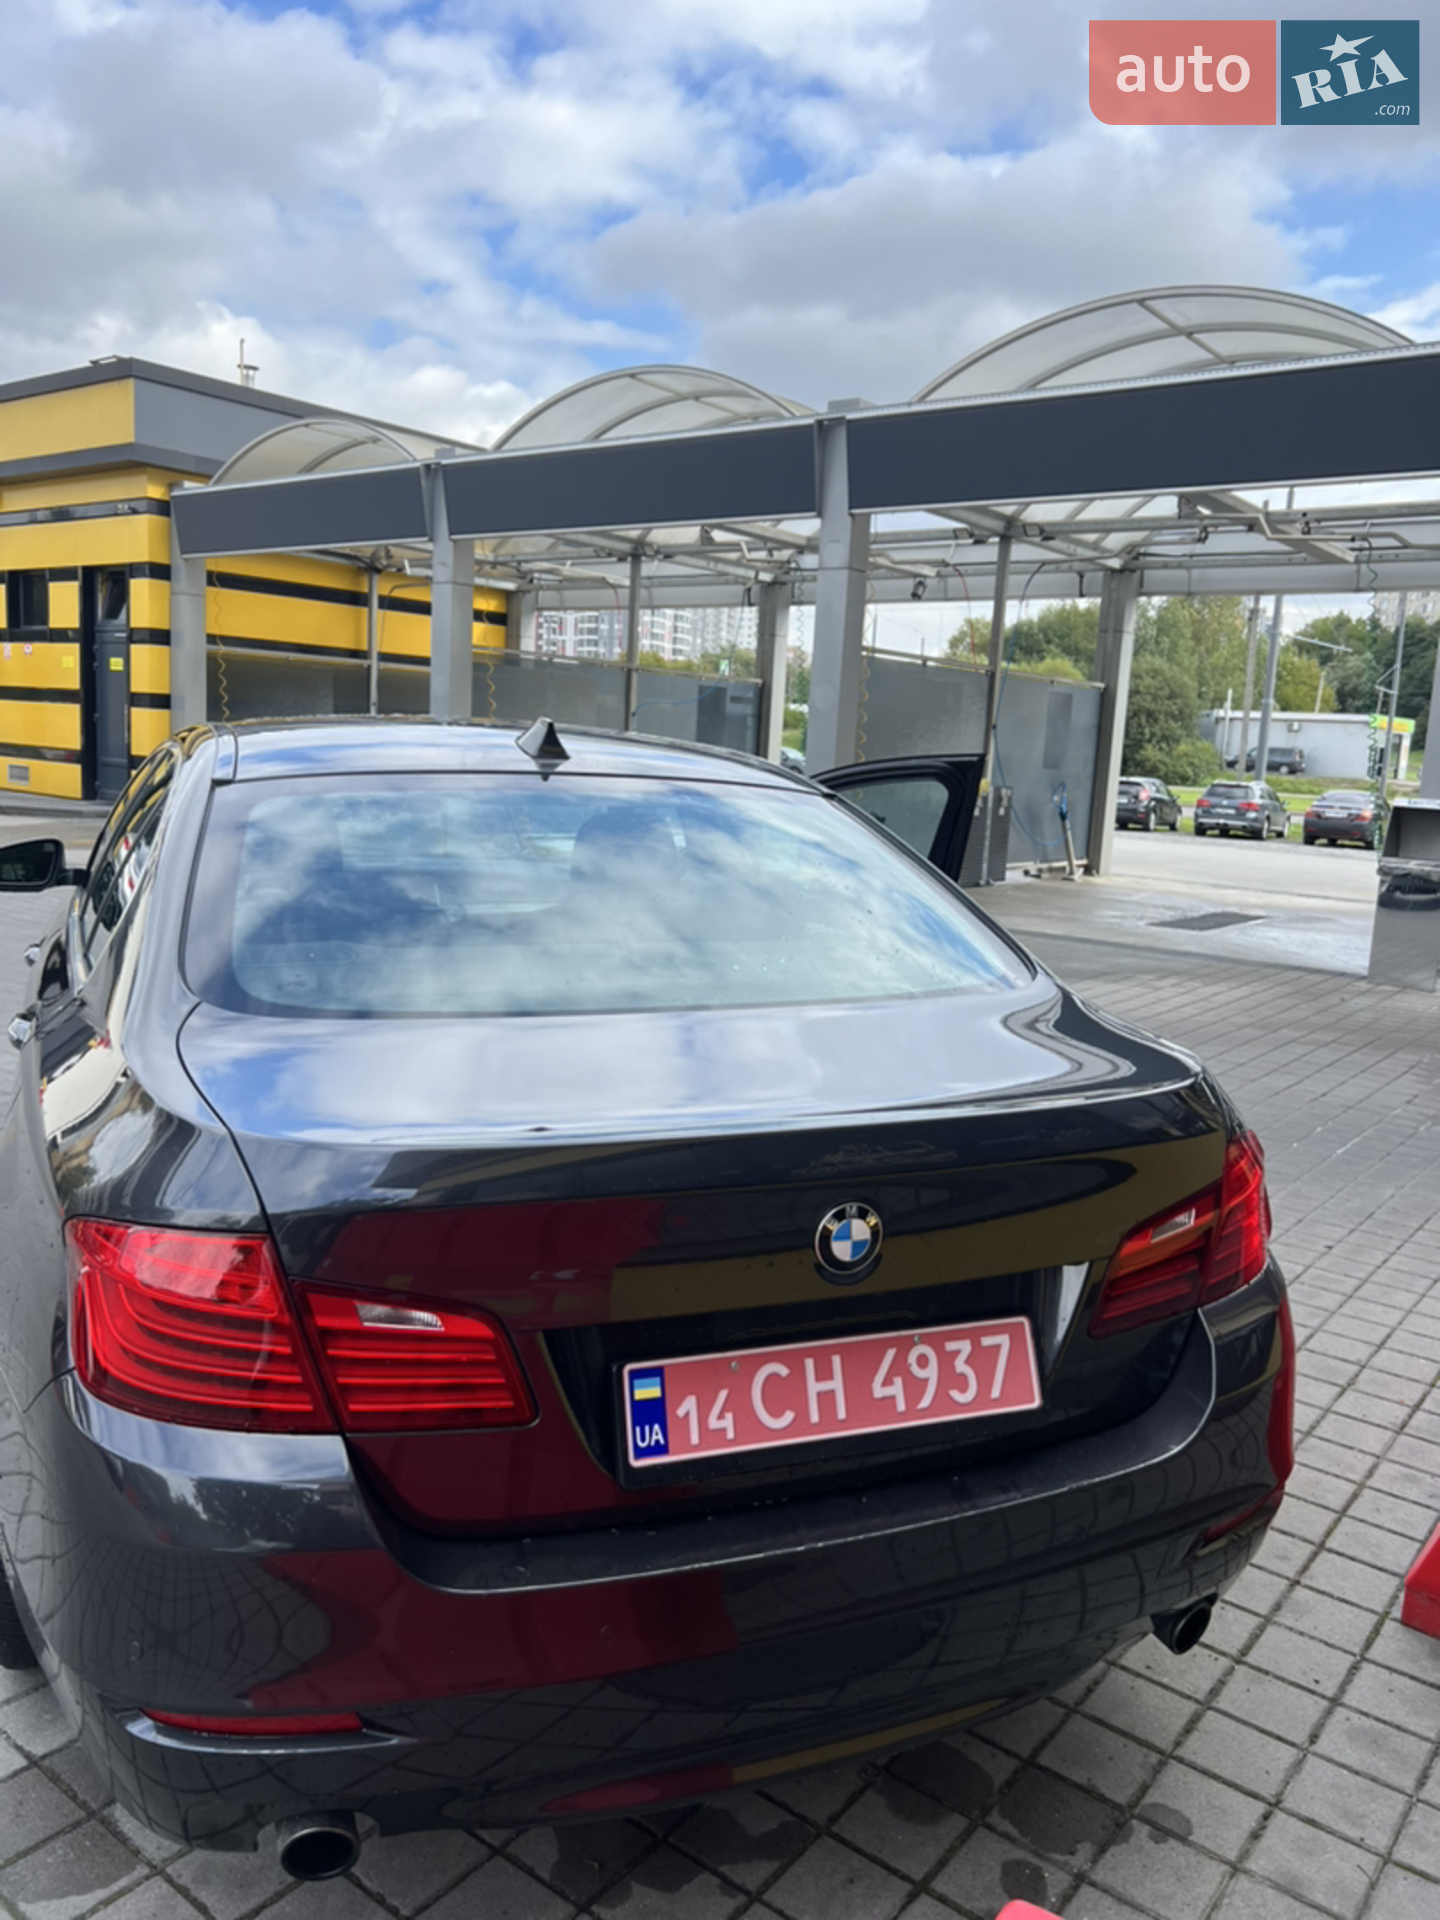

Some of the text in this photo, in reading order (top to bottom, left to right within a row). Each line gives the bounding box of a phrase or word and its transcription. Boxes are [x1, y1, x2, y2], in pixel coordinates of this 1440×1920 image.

[825, 1205, 879, 1231] BMW
[675, 1333, 1011, 1446] 14 CH 4937
[635, 1423, 665, 1448] UA
